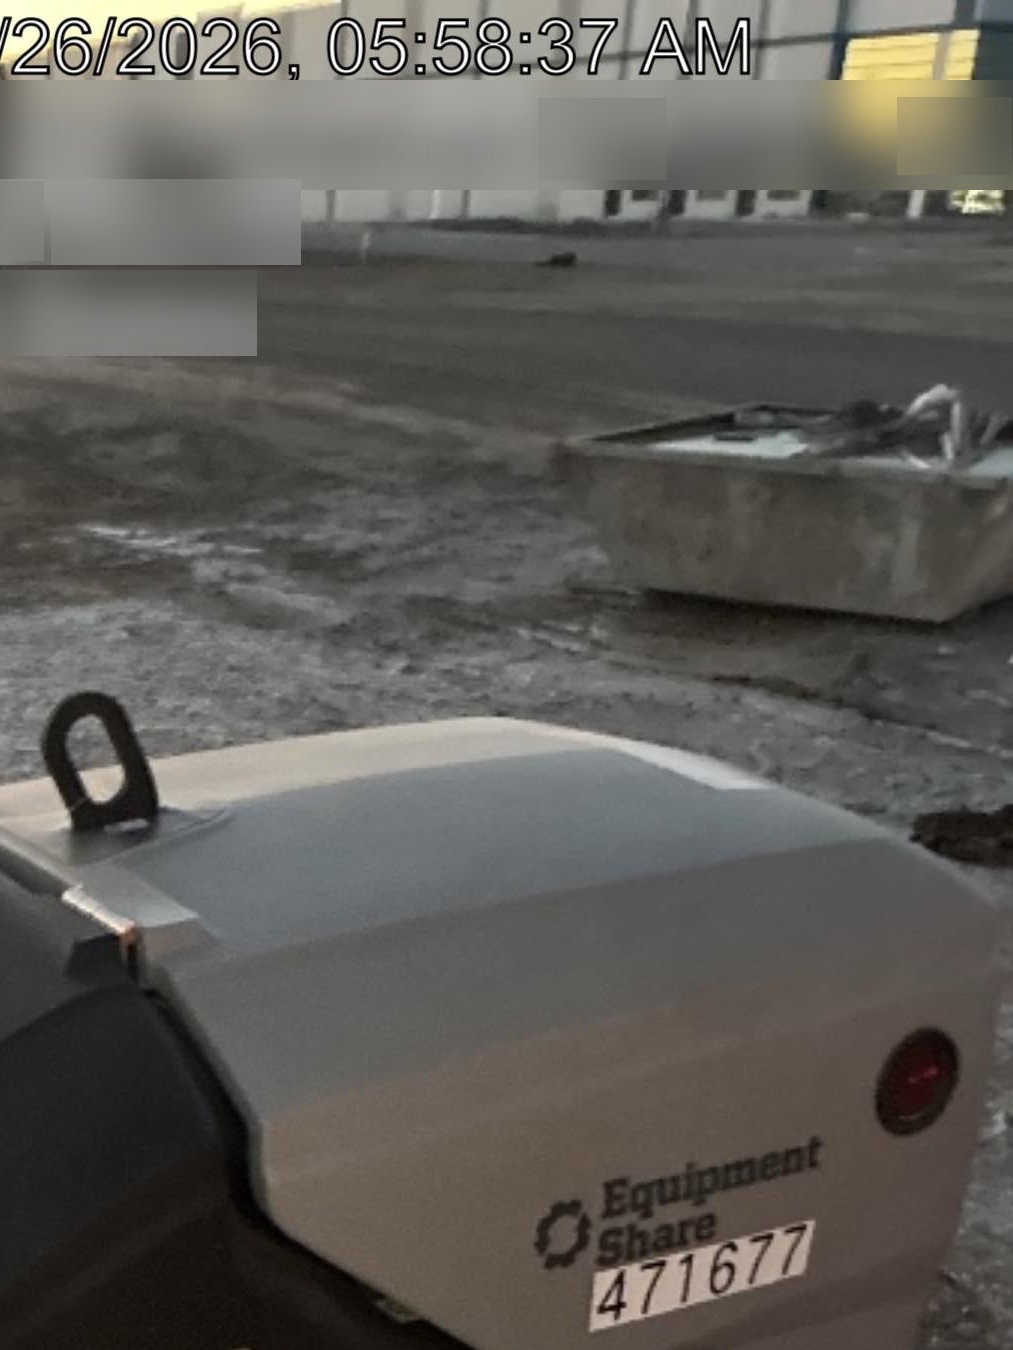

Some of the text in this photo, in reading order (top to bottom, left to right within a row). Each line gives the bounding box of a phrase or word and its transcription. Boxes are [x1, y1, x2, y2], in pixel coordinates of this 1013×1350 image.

[602, 1136, 823, 1219] Equipment
[595, 1213, 717, 1266] Share
[597, 1225, 807, 1320] 471677
